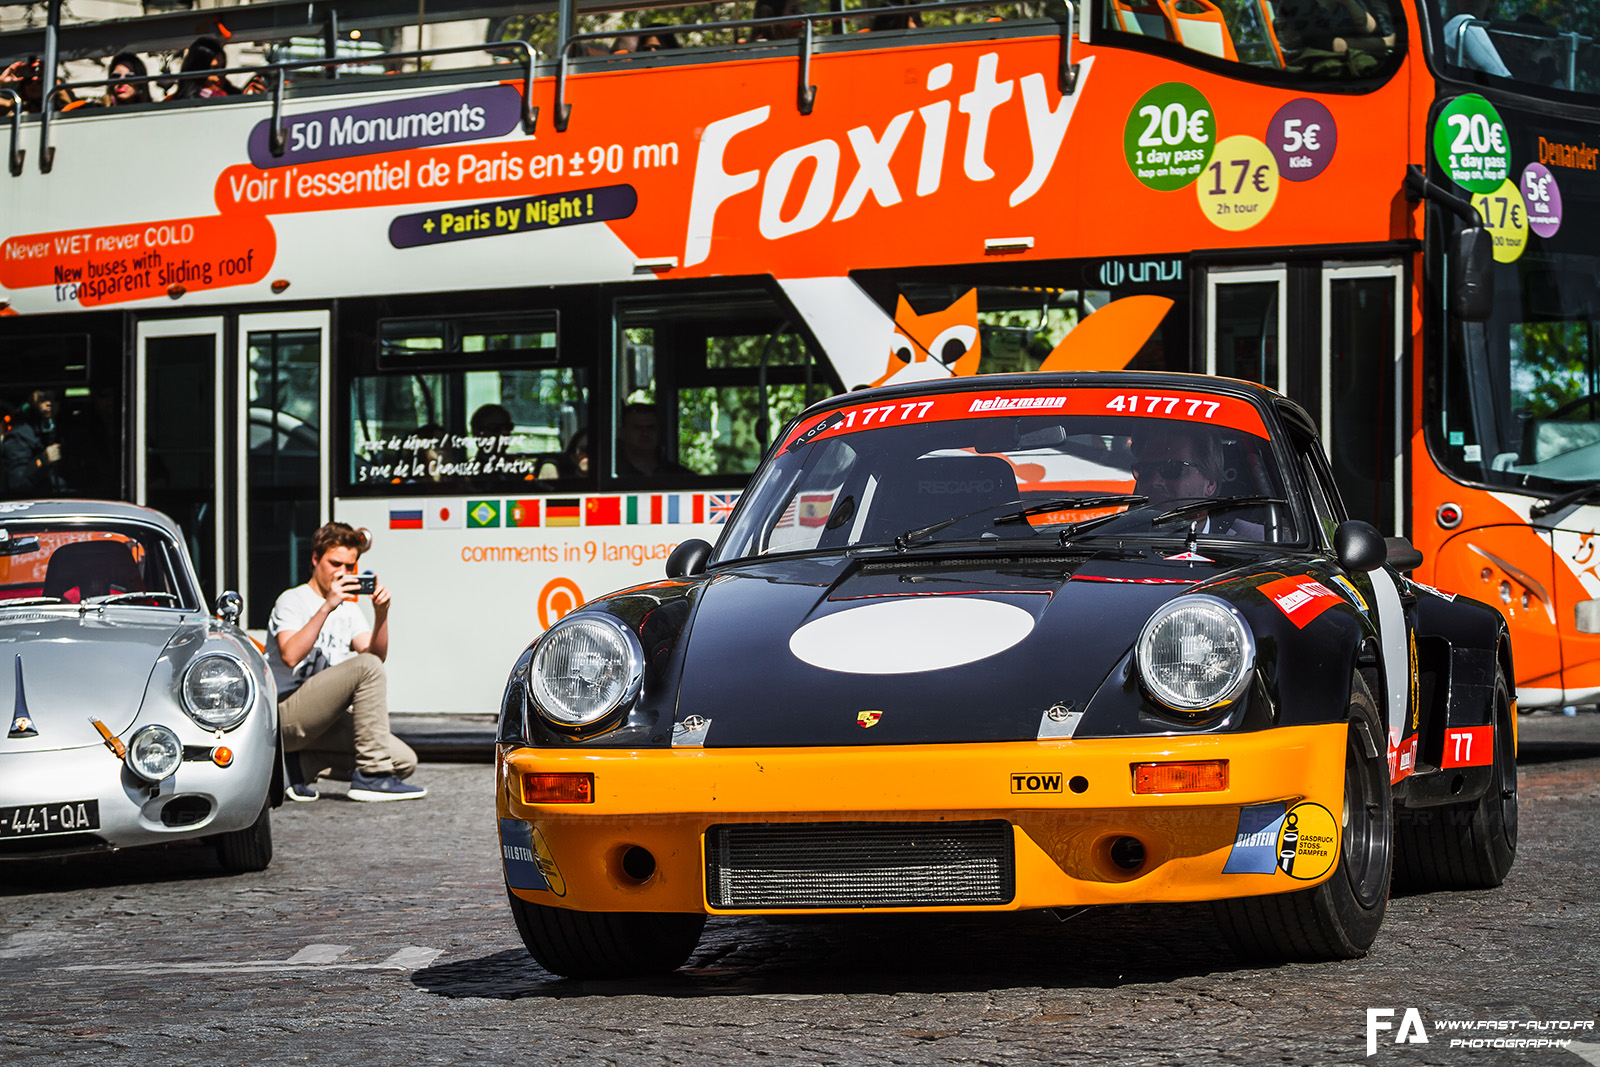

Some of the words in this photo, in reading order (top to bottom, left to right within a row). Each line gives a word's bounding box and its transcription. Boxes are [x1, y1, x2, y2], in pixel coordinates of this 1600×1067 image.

[291, 120, 322, 151] 50
[329, 103, 486, 147] Monuments
[1138, 103, 1209, 147] 20€
[1282, 119, 1320, 152] 5€
[1447, 113, 1506, 154] 20€
[684, 52, 1096, 267] Foxity
[1135, 151, 1144, 165] 1
[1146, 149, 1173, 165] day
[1174, 149, 1204, 165] pass
[1289, 157, 1313, 169] Kids
[1449, 155, 1459, 169] 1
[1461, 154, 1483, 170] day
[1485, 156, 1507, 170] pass
[1538, 136, 1599, 171] Demander
[230, 172, 277, 203] Voir
[285, 160, 410, 199] l'essentiel
[417, 158, 450, 187] de
[457, 151, 523, 184] Paris
[529, 154, 563, 178] en
[633, 142, 678, 169] mn
[1138, 168, 1152, 179] hop
[1156, 168, 1168, 176] on
[1169, 166, 1186, 176] hop
[1188, 165, 1201, 175] off
[1208, 159, 1270, 195] 17€
[441, 209, 490, 235] Paris
[496, 206, 520, 231] by
[526, 197, 582, 226] Night
[1216, 203, 1230, 214] 2h
[1234, 203, 1258, 214] tour
[1479, 197, 1523, 230] 17€
[5, 241, 49, 261] Never
[54, 234, 92, 255] WET
[95, 232, 140, 251] never
[144, 224, 194, 247] COLD
[1506, 237, 1522, 247] tour
[54, 265, 82, 284] New
[88, 260, 127, 279] buses
[133, 250, 162, 271] with
[55, 269, 151, 302] transparent
[158, 261, 212, 285] sliding
[219, 249, 254, 277] roof
[968, 396, 1068, 412] heinzmann
[370, 463, 391, 478] rue
[393, 459, 409, 477] de
[412, 455, 425, 476] la
[428, 454, 480, 477] Chaussée
[461, 543, 558, 563] comments
[562, 542, 580, 562] in
[584, 541, 597, 563] 9
[1451, 733, 1472, 761] 77
[1012, 775, 1060, 791] TOW
[1235, 832, 1277, 848] BILSTEIN
[1300, 834, 1334, 844] GASDRUCK
[503, 845, 534, 863] BILSTEIN
